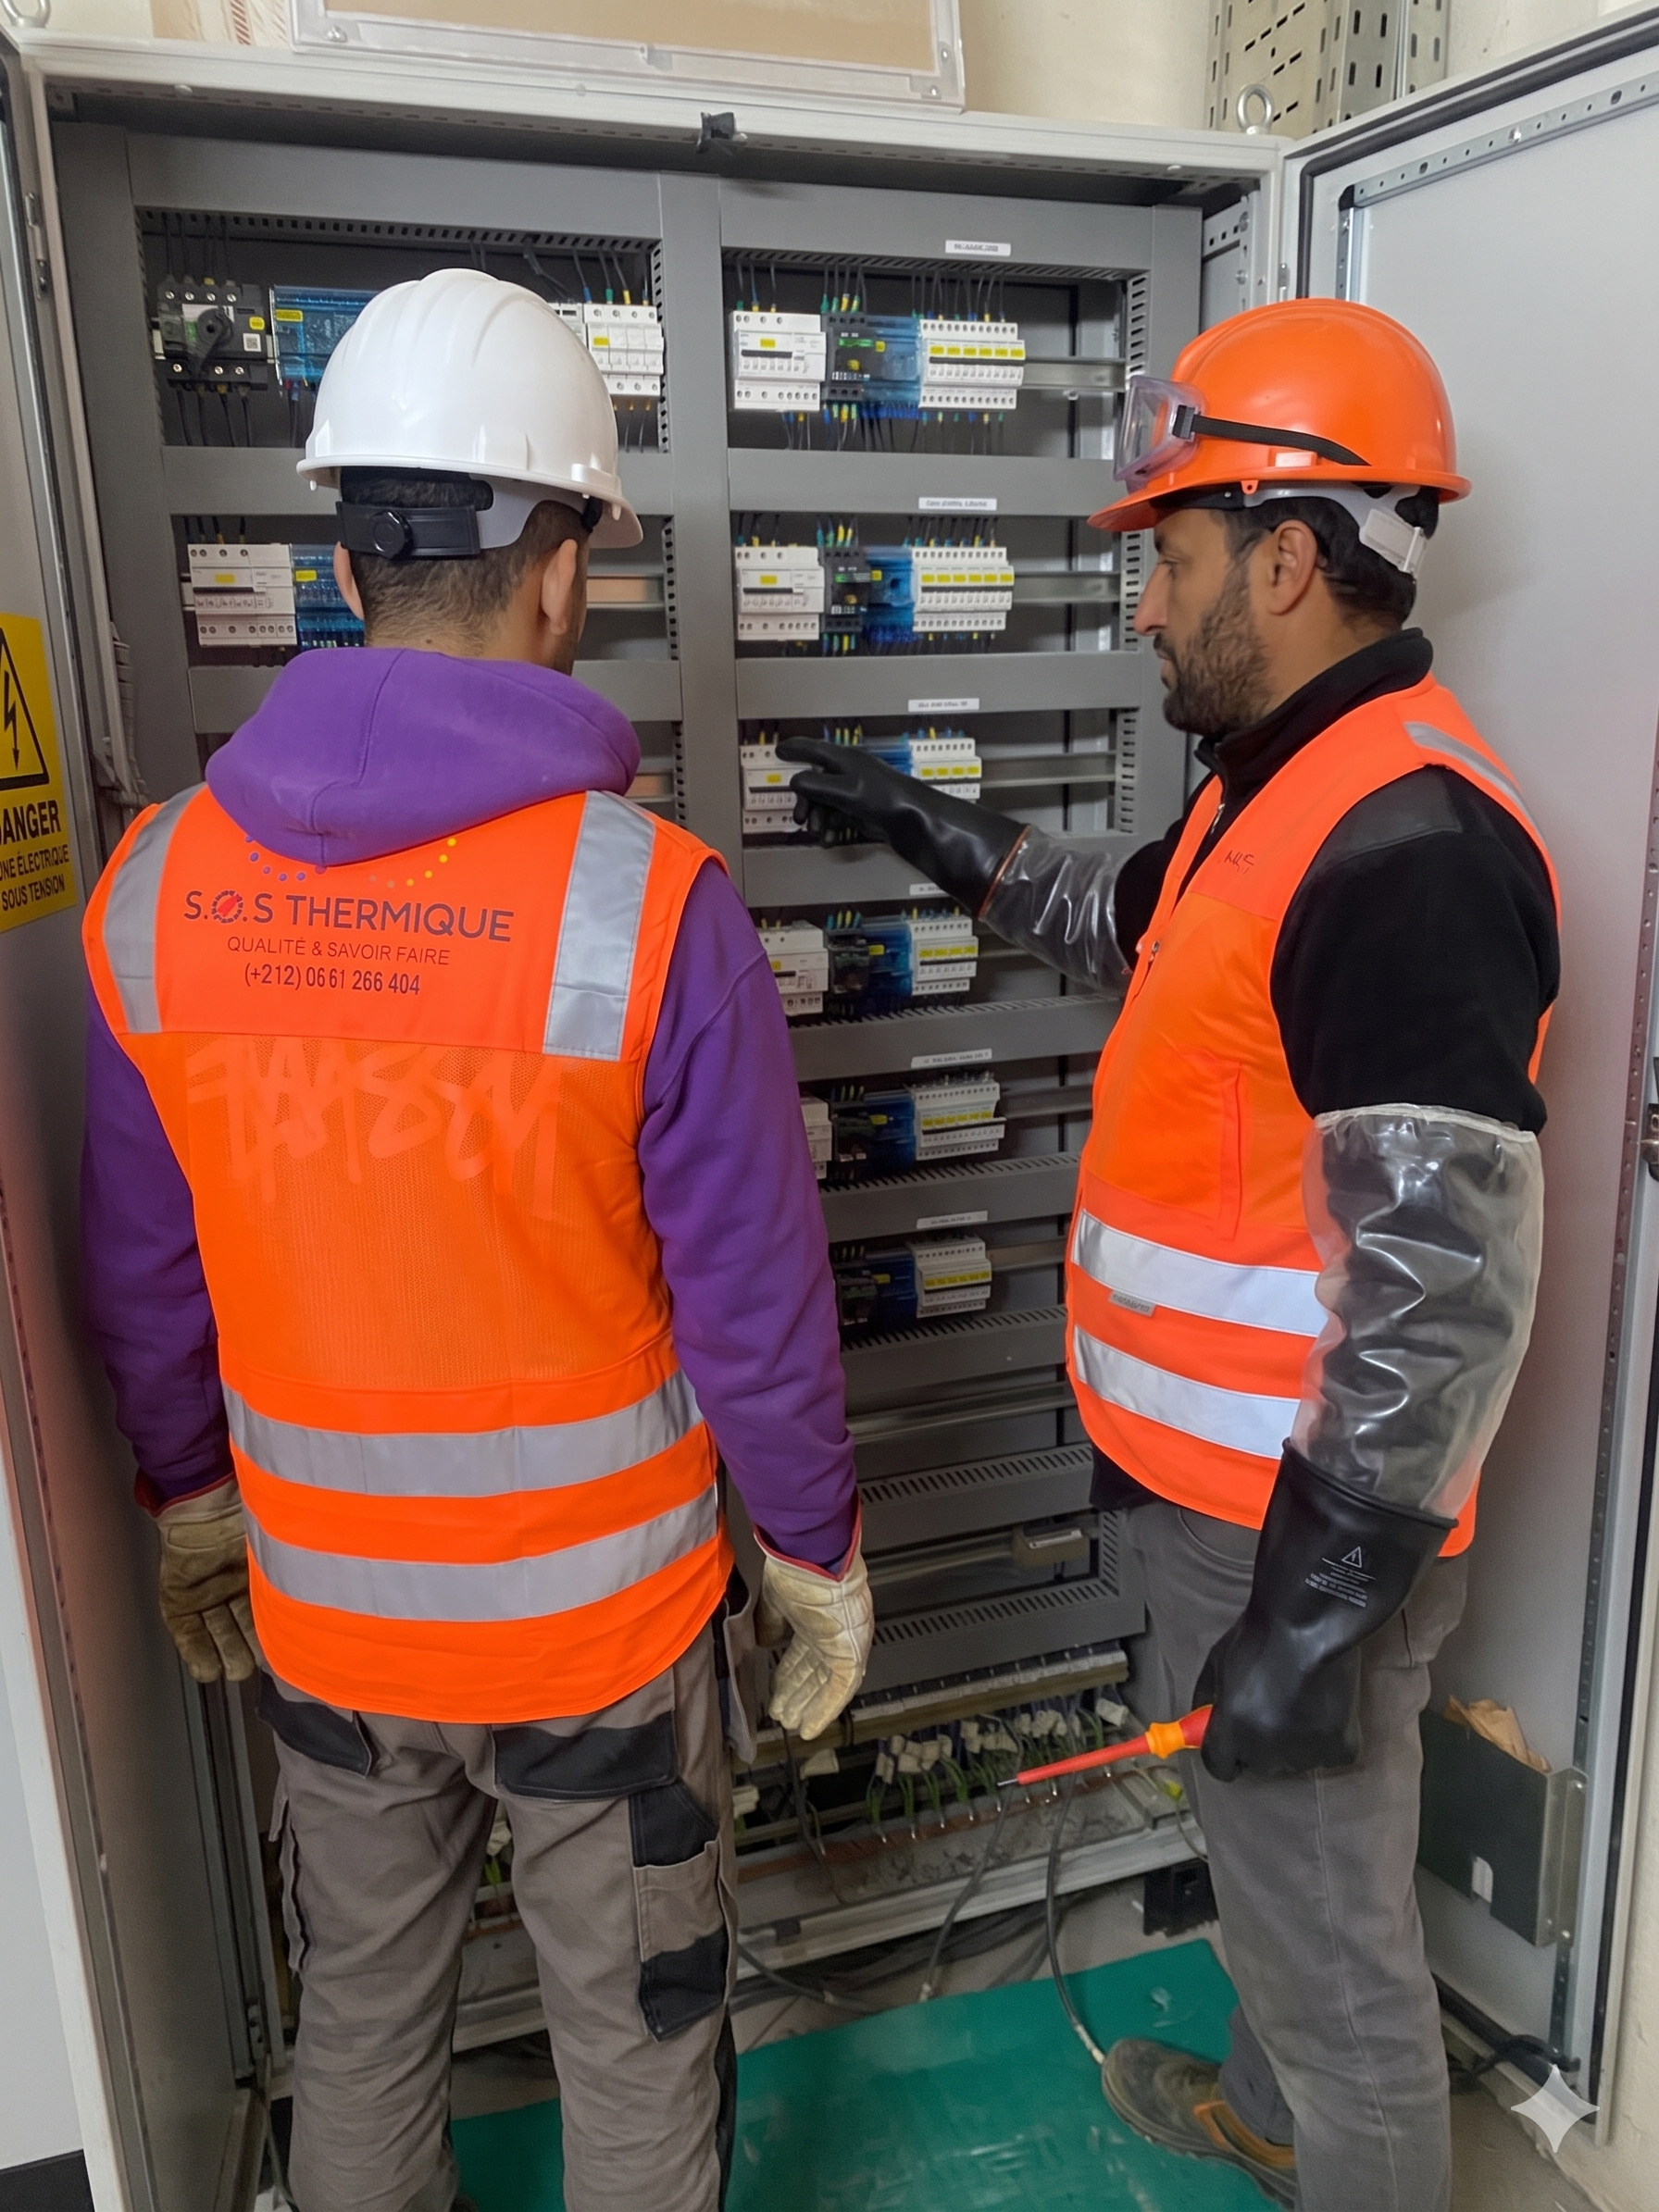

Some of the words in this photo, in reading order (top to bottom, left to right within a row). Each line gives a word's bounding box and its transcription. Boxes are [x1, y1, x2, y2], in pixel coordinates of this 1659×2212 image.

[0, 800, 61, 846] ANGER
[17, 844, 69, 876] ÉLECTRIQUE
[2, 885, 28, 912] SOUS
[28, 874, 66, 902] TENSION
[285, 894, 515, 942] THERMIQUE
[227, 936, 306, 956] QUALITÉ
[311, 940, 323, 957] &
[327, 941, 392, 962] SAVOIR
[396, 946, 451, 966] FAIRE
[244, 962, 302, 991] (+212)
[352, 969, 383, 993] 266
[388, 972, 420, 996] 404
